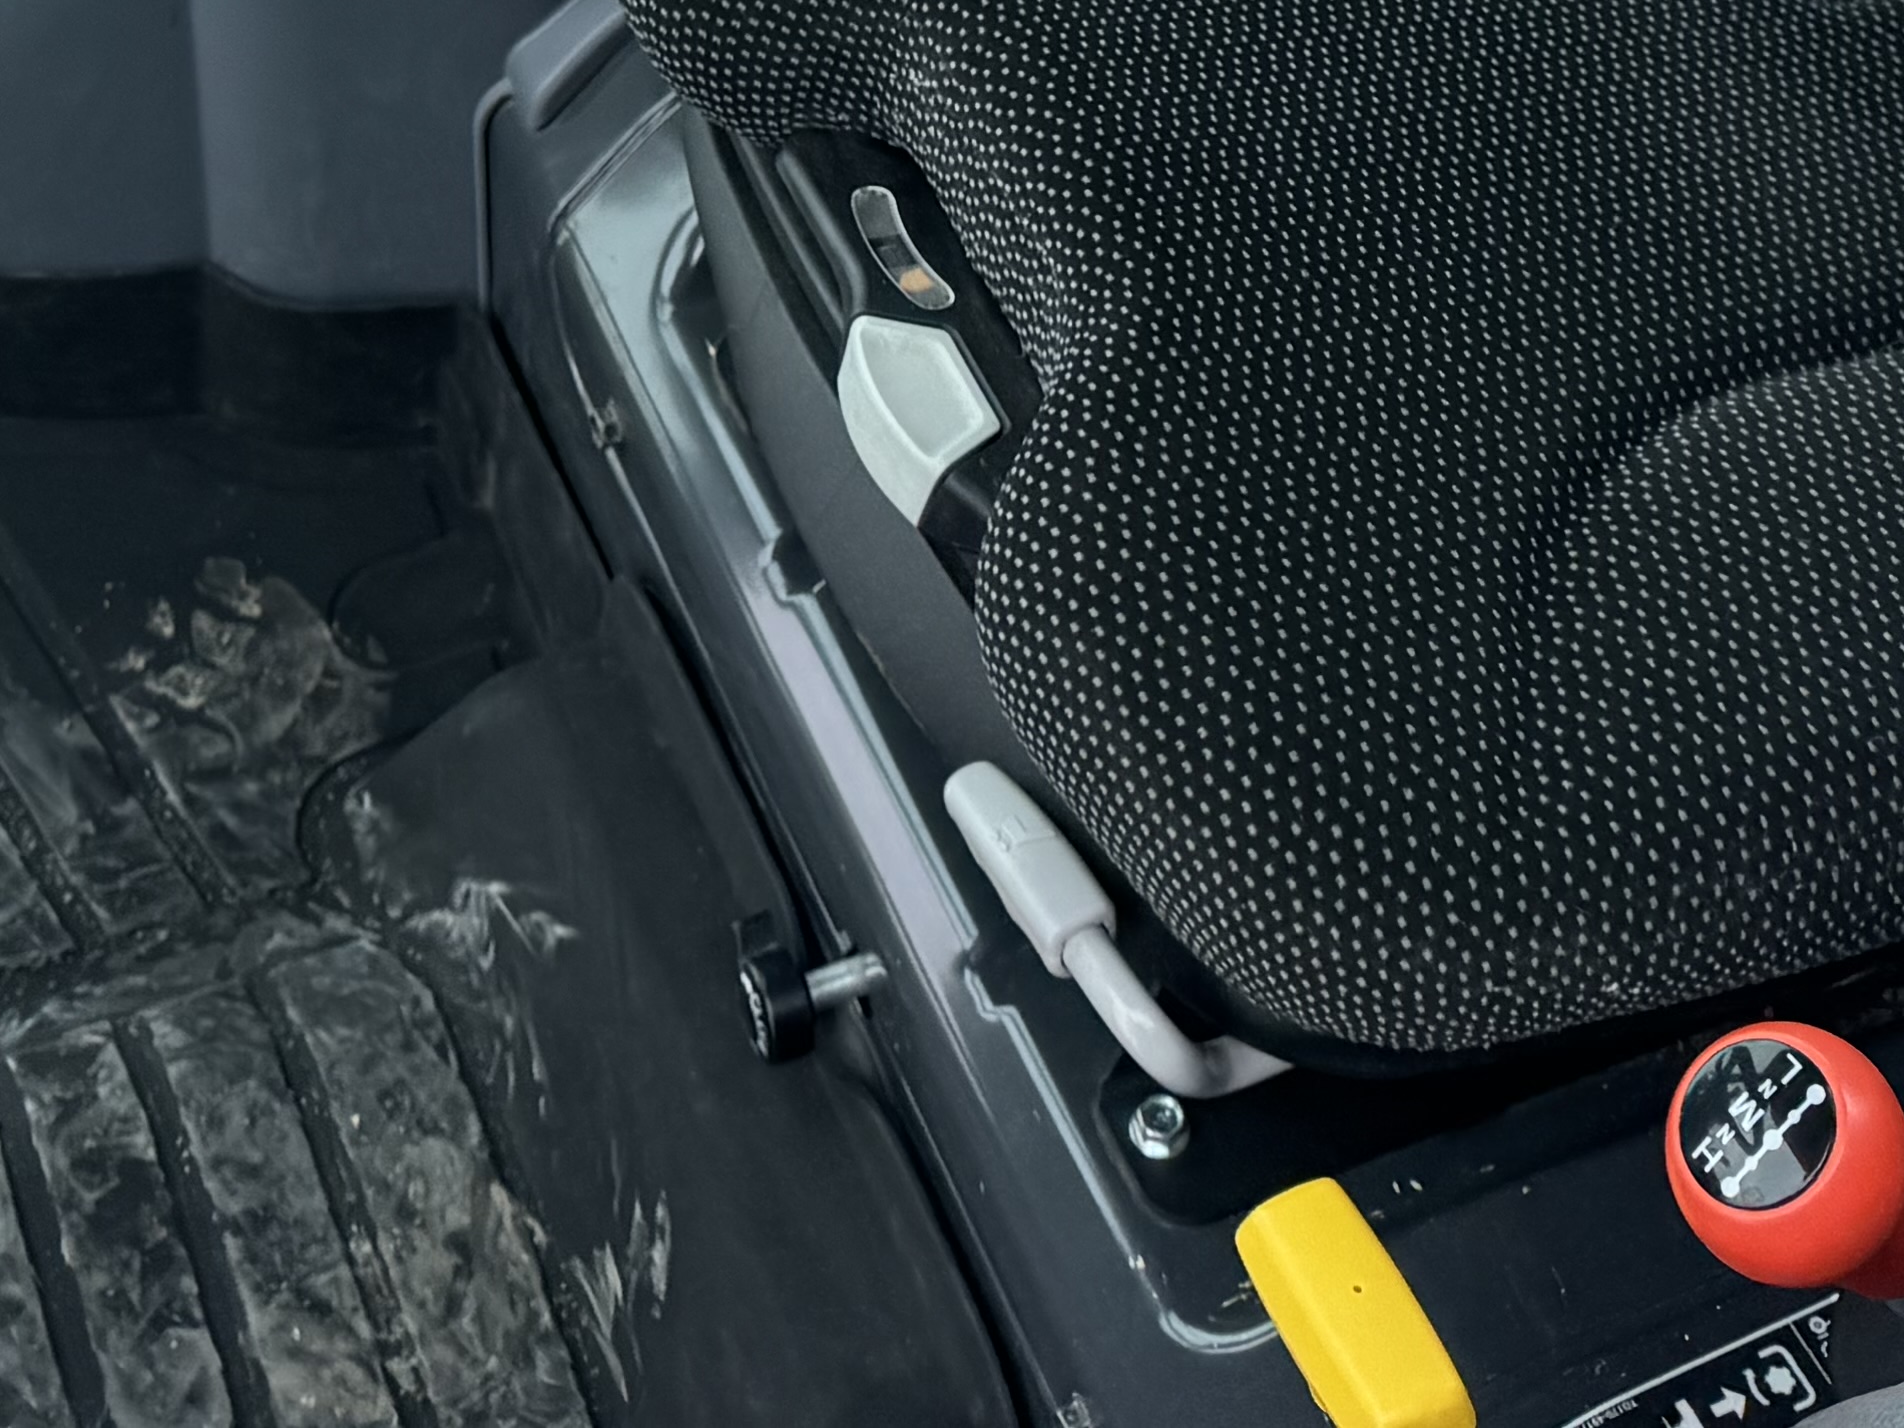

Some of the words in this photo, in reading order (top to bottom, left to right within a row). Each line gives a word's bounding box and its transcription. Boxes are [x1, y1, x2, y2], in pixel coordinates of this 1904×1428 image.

[1692, 1136, 1724, 1173] H
[1728, 1091, 1765, 1132] M
[1781, 1052, 1803, 1085] L
